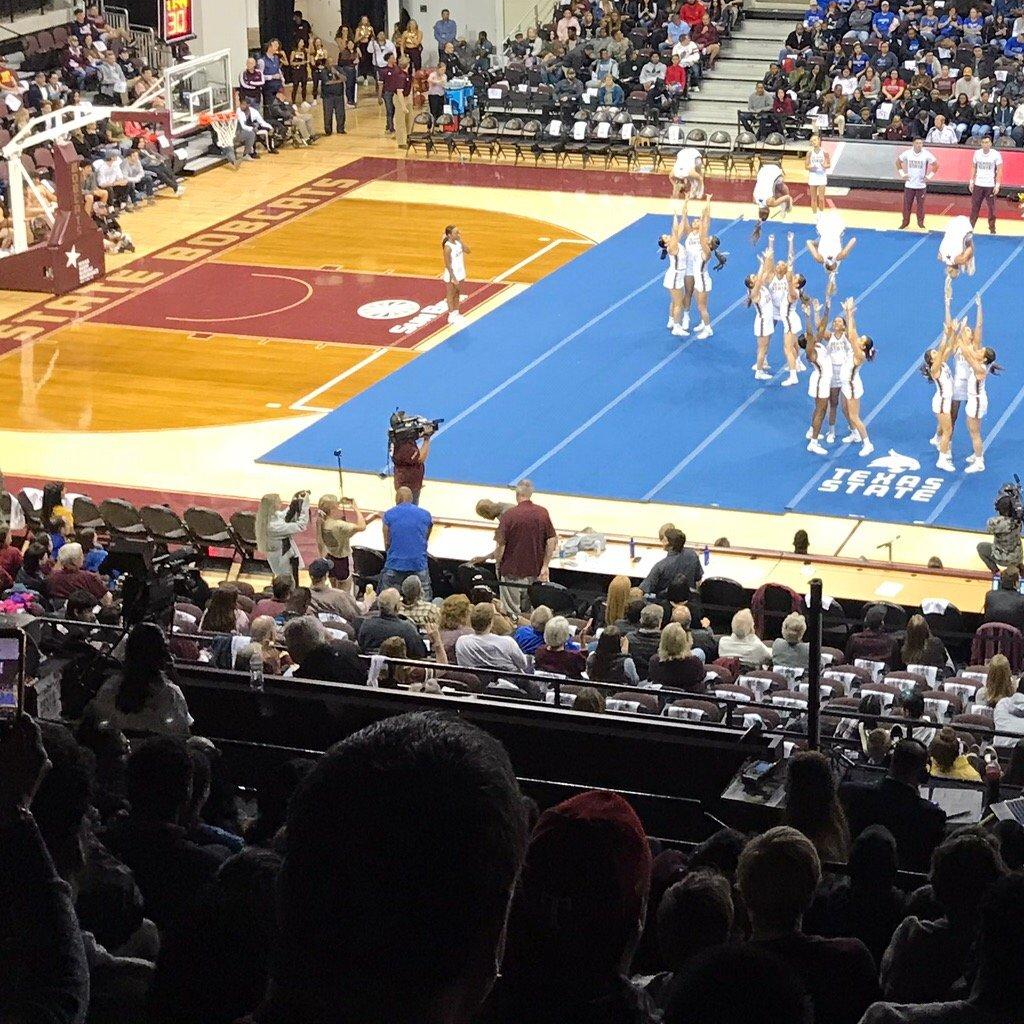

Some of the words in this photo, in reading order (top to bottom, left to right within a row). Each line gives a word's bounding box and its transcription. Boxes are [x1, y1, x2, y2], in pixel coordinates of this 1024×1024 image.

[167, 9, 187, 35] 30
[0, 269, 164, 341] STATE
[152, 177, 360, 263] BOBCATS
[817, 478, 938, 503] STATE
[832, 467, 944, 491] TEXAS
